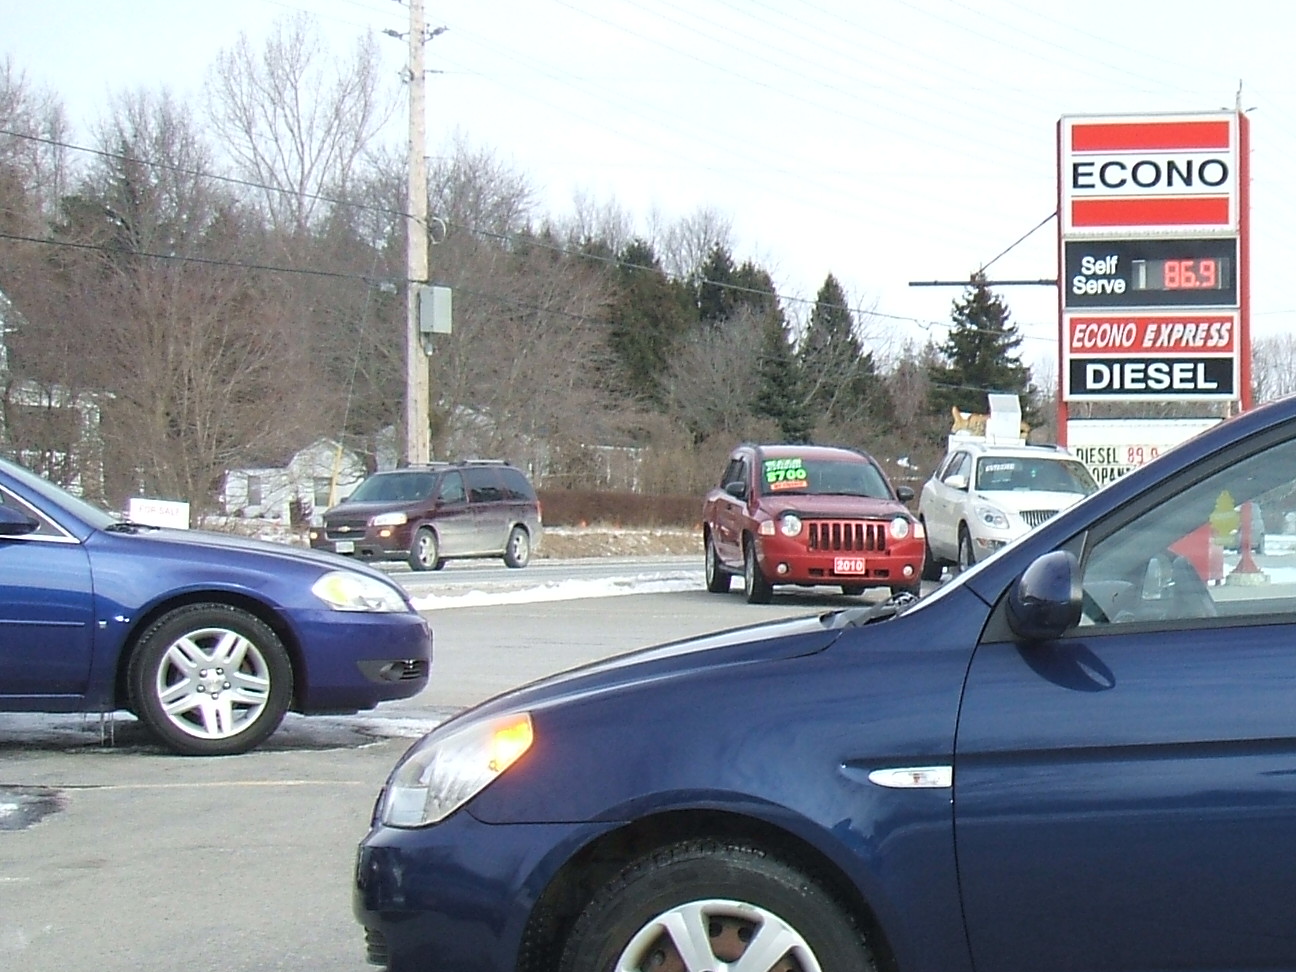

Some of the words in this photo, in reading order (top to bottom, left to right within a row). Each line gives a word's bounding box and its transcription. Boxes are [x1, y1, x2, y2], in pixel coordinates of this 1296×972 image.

[1072, 158, 1229, 189] ECONO
[1081, 255, 1118, 275] Self
[1163, 259, 1216, 288] 86.9
[1072, 275, 1126, 295] Serve
[1072, 323, 1137, 348] ECONO
[1142, 322, 1231, 347] EXPRESS
[1086, 362, 1218, 389] DIESEL
[1076, 447, 1119, 465] DIESEL
[837, 560, 863, 571] 2010
